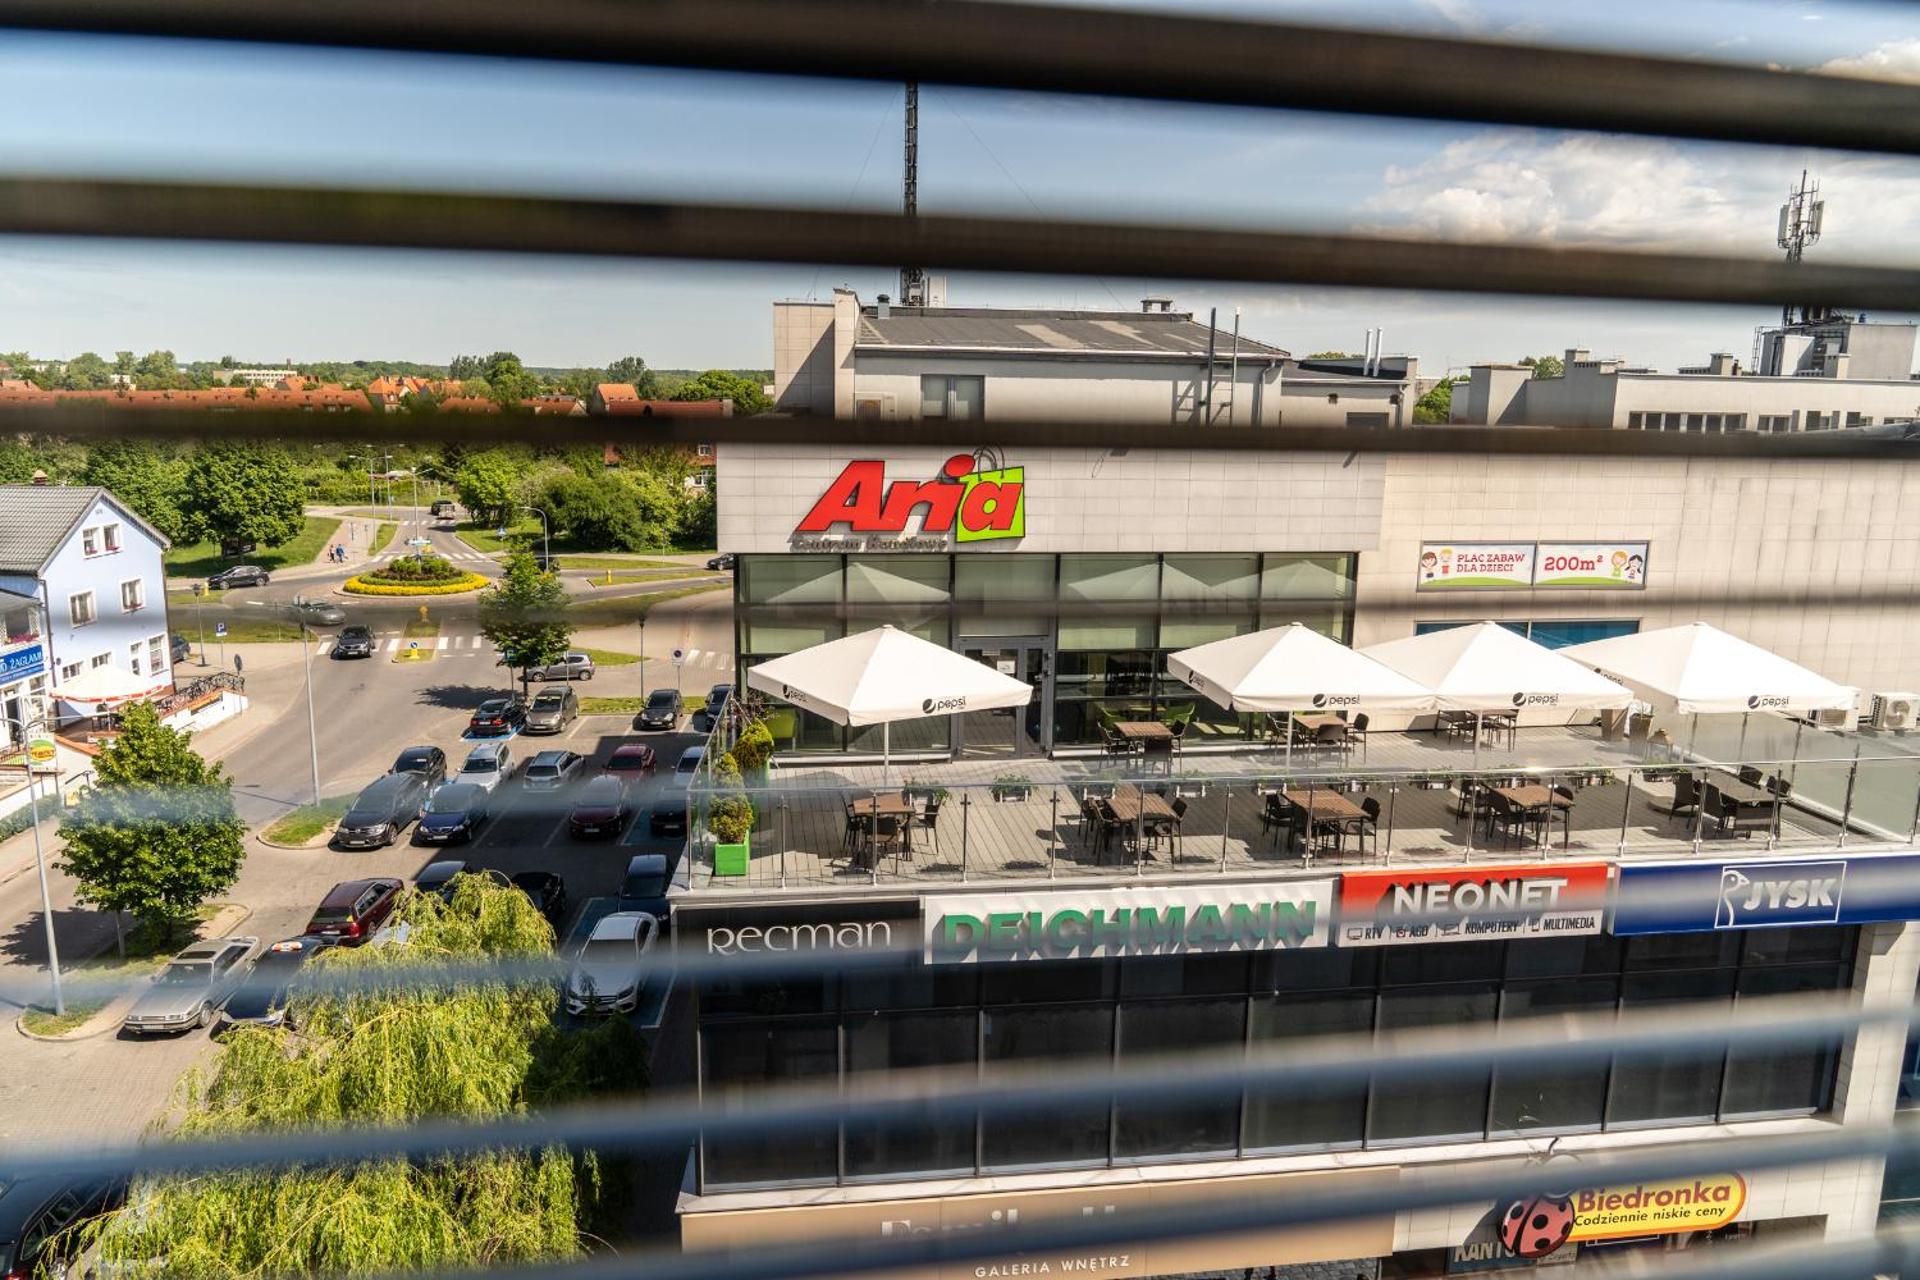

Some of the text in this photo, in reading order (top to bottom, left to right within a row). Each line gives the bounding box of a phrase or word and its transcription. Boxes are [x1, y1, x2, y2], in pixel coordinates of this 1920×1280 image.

[795, 454, 1024, 532] Aria
[1456, 562, 1514, 573] DLA DZIECI
[1457, 553, 1526, 563] PLAC ZABAW
[937, 696, 966, 711] pepsi
[1328, 694, 1360, 705] pepsi
[1527, 693, 1559, 705] pepsi
[1761, 695, 1789, 707] pepsi
[1393, 878, 1568, 915] NEONET
[1743, 878, 1837, 911] JYSK
[942, 901, 1317, 953] DEICHMANN
[1365, 927, 1383, 940] RTV
[1464, 919, 1519, 935] KOMPUTERY
[1542, 916, 1596, 931] MULTIMEDIA
[1577, 1181, 1731, 1213] Biedronka
[1574, 1207, 1726, 1226] Codziennie niskie ceny
[974, 1255, 1131, 1278] GALERIA WNĘTRZ
